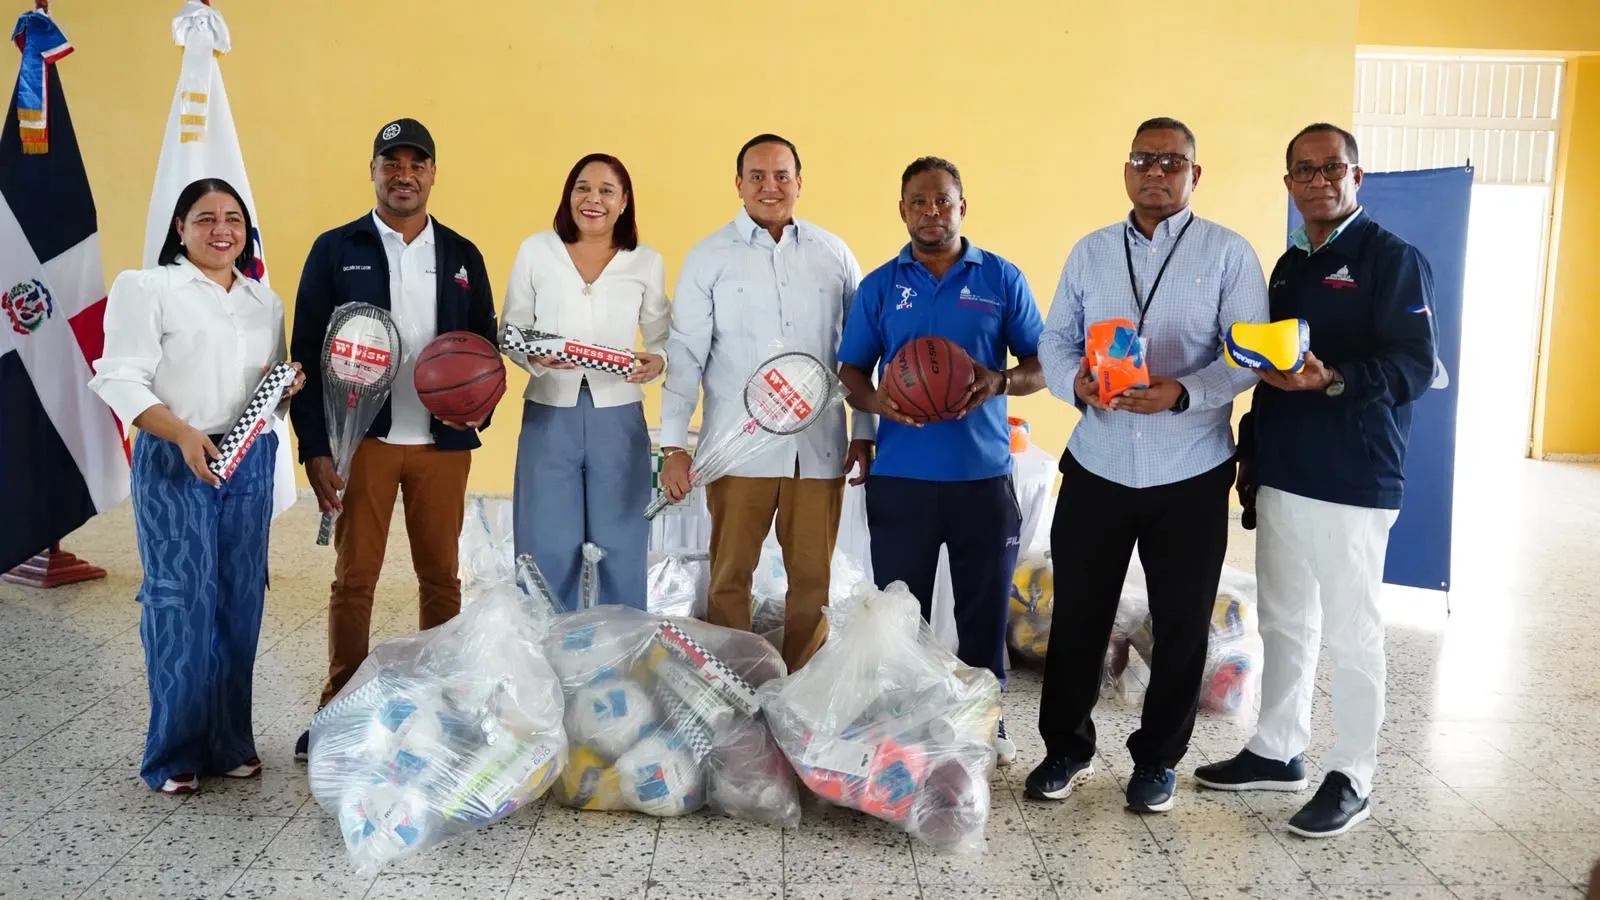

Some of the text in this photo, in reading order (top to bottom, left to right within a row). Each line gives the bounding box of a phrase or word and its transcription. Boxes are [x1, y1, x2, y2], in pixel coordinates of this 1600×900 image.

[568, 345, 603, 359] CHESS
[607, 355, 627, 365] SET
[1005, 536, 1020, 547] FIL
